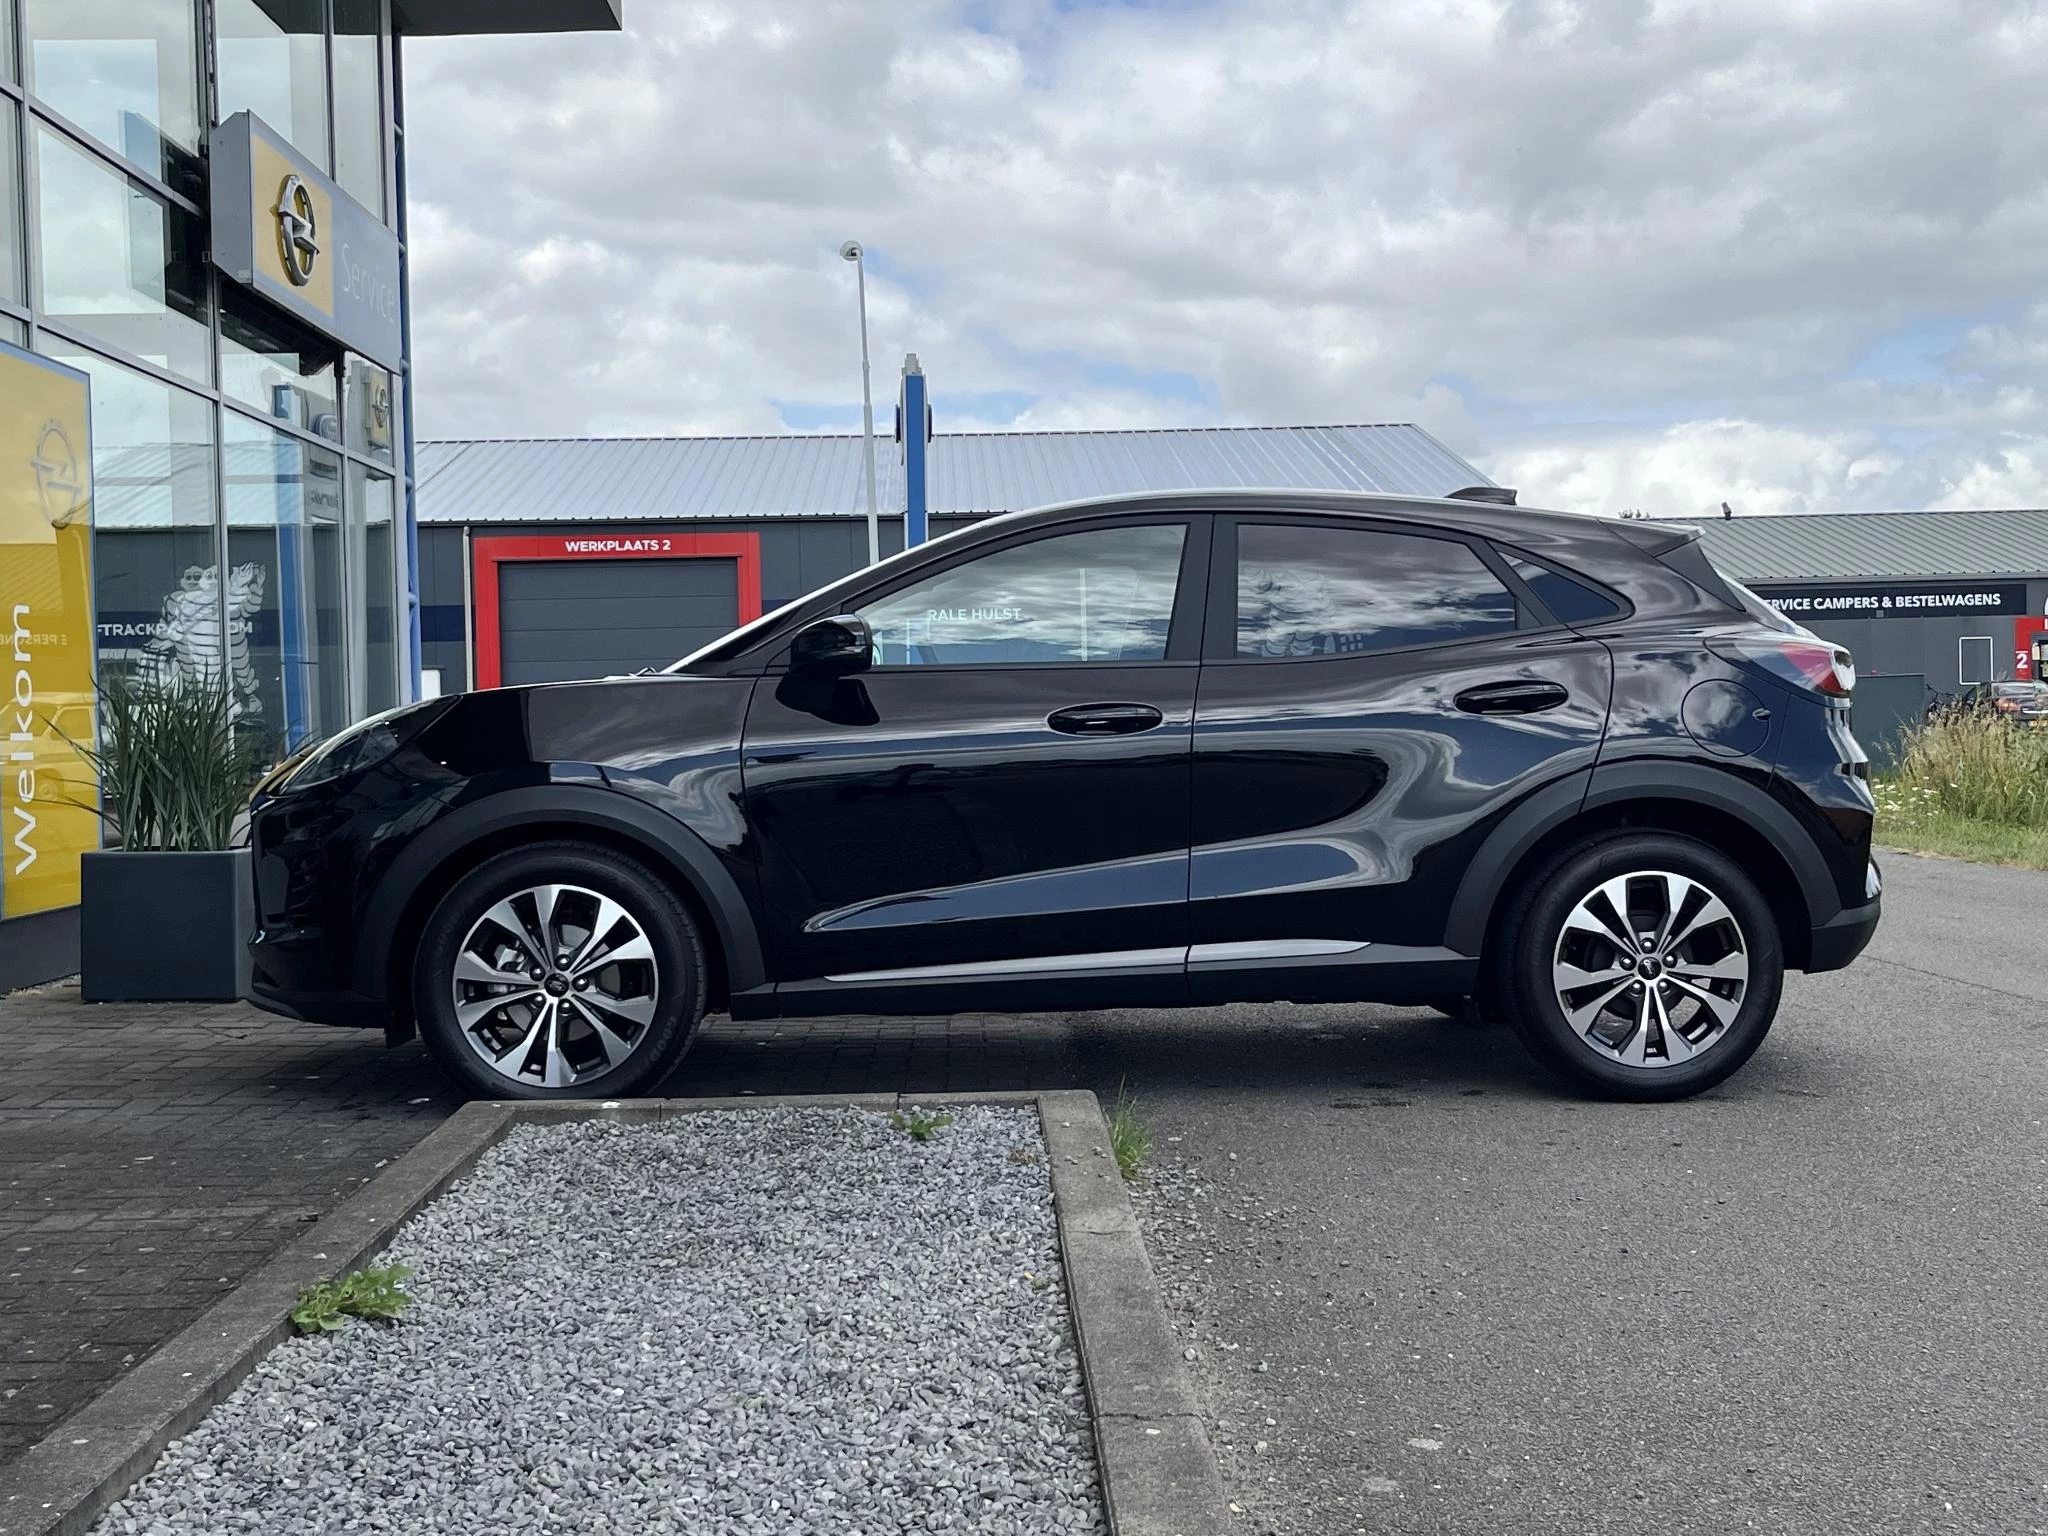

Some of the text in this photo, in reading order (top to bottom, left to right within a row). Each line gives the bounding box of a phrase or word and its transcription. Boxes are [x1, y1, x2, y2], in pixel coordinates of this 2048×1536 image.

[342, 243, 395, 323] Service
[565, 539, 672, 552] WERKPLAATS 2
[1813, 597, 1879, 609] CAMPERS
[1881, 596, 1893, 608] &
[1895, 593, 2001, 608] BESTELWAGENS
[971, 607, 1022, 620] HULST
[2016, 653, 2028, 669] 2
[10, 603, 37, 876] Welkom
